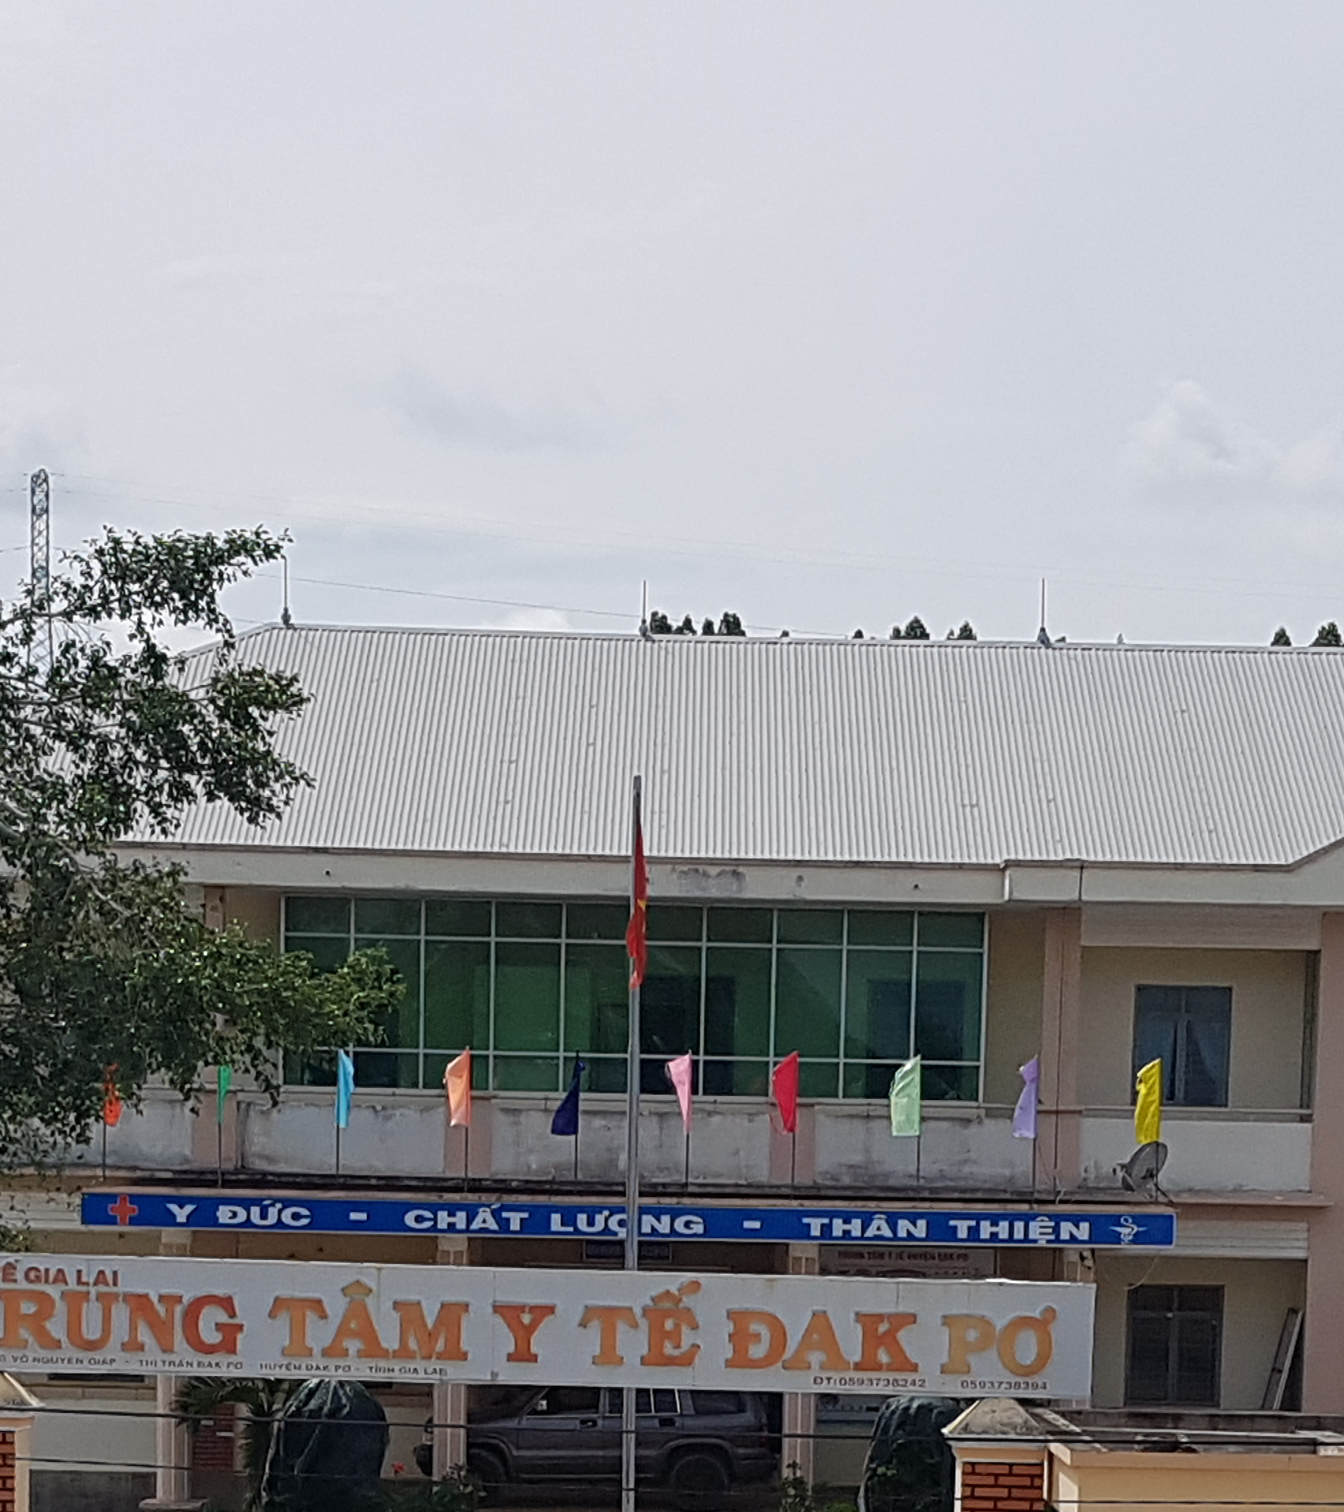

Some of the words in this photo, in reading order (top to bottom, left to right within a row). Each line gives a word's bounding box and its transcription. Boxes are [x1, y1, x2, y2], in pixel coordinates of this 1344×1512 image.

[165, 1203, 198, 1225] Y
[216, 1199, 313, 1228] ĐỨC
[403, 1203, 530, 1232] CHẤT
[550, 1211, 705, 1238] LƯỢNG
[802, 1212, 927, 1240] THÂN
[948, 1214, 1093, 1245] THIỆN
[24, 1266, 68, 1286] GIA
[76, 1269, 119, 1287] LAI
[268, 1279, 470, 1361] TÂM
[493, 1303, 555, 1363] Y
[578, 1280, 700, 1367] TẾ
[725, 1309, 920, 1373] ĐAK
[939, 1304, 1057, 1378] PƠ
